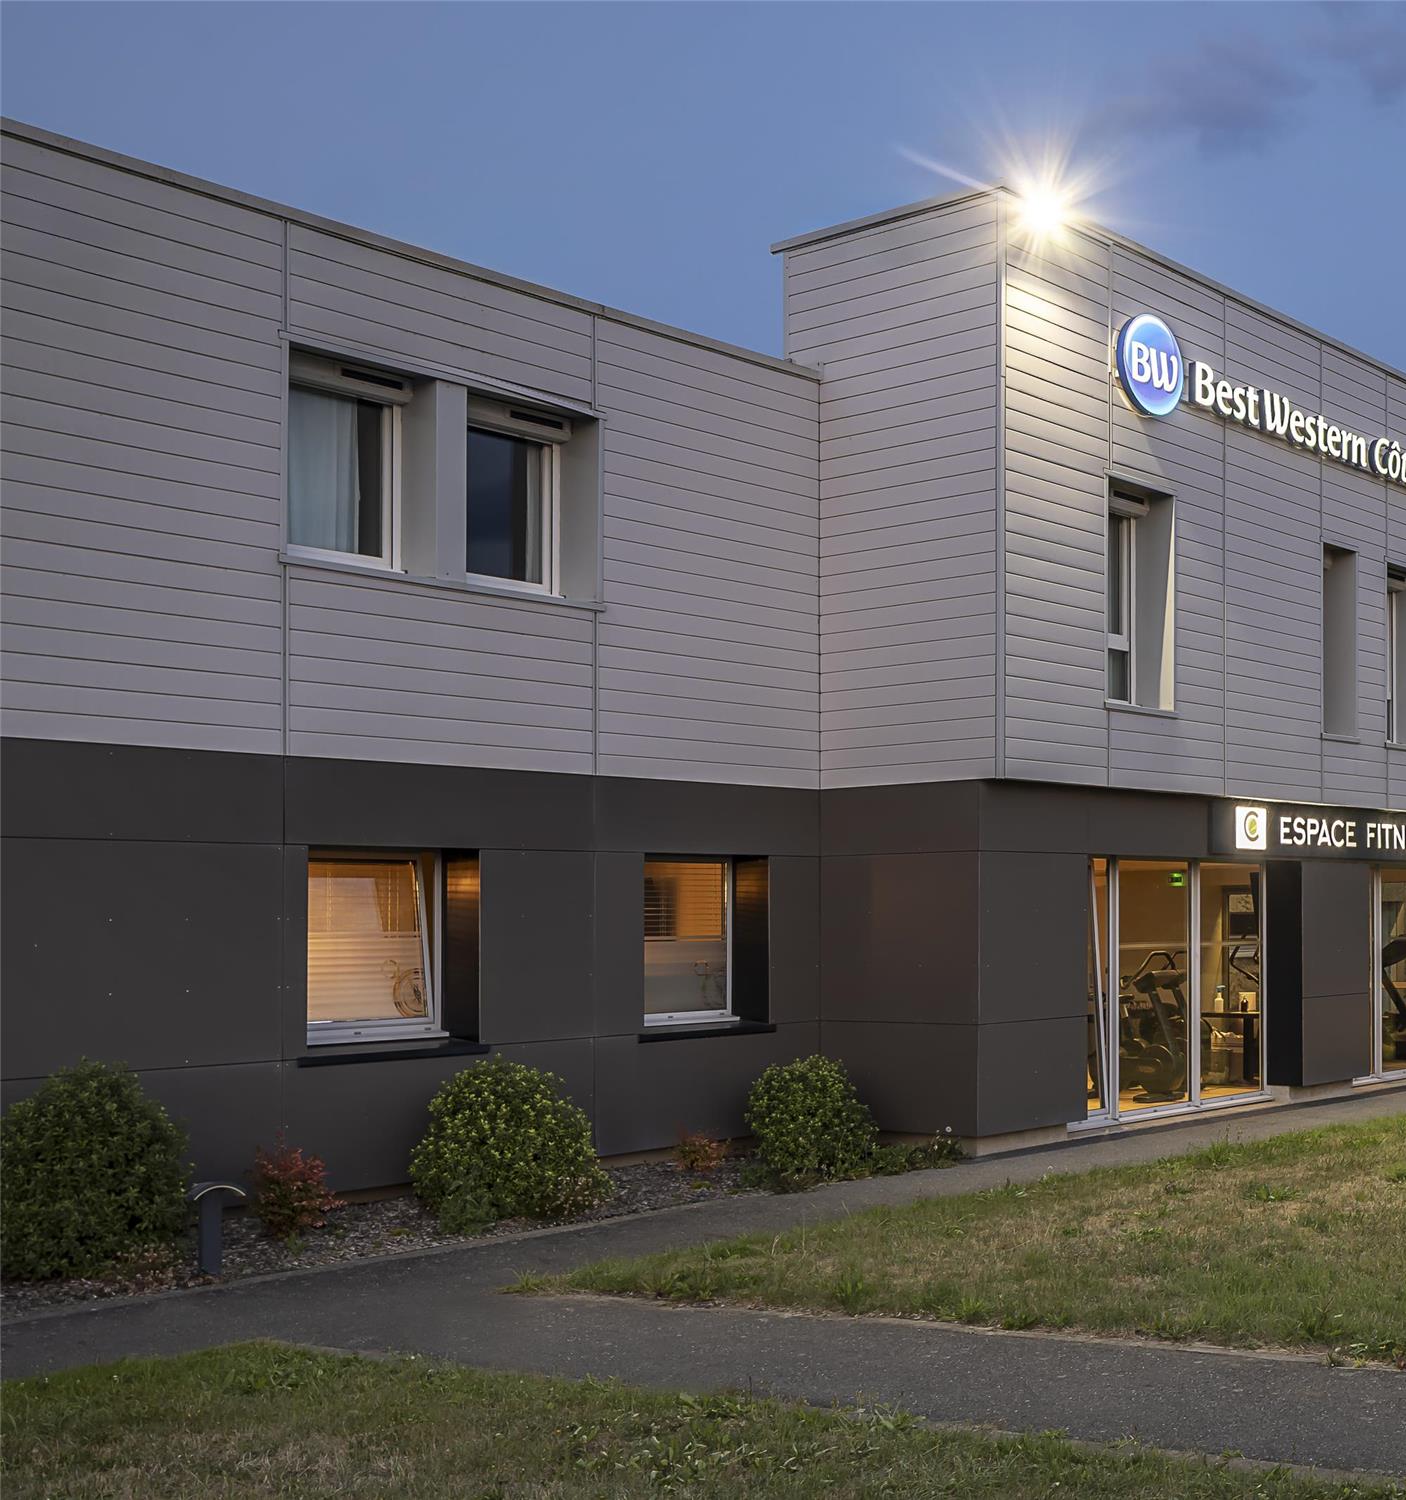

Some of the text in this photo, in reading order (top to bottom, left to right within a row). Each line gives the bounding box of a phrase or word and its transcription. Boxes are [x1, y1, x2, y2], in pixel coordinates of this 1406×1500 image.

[1131, 341, 1178, 393] BW
[1194, 360, 1260, 426] Best
[1262, 388, 1368, 468] Western
[1279, 816, 1357, 848] ESPACE
